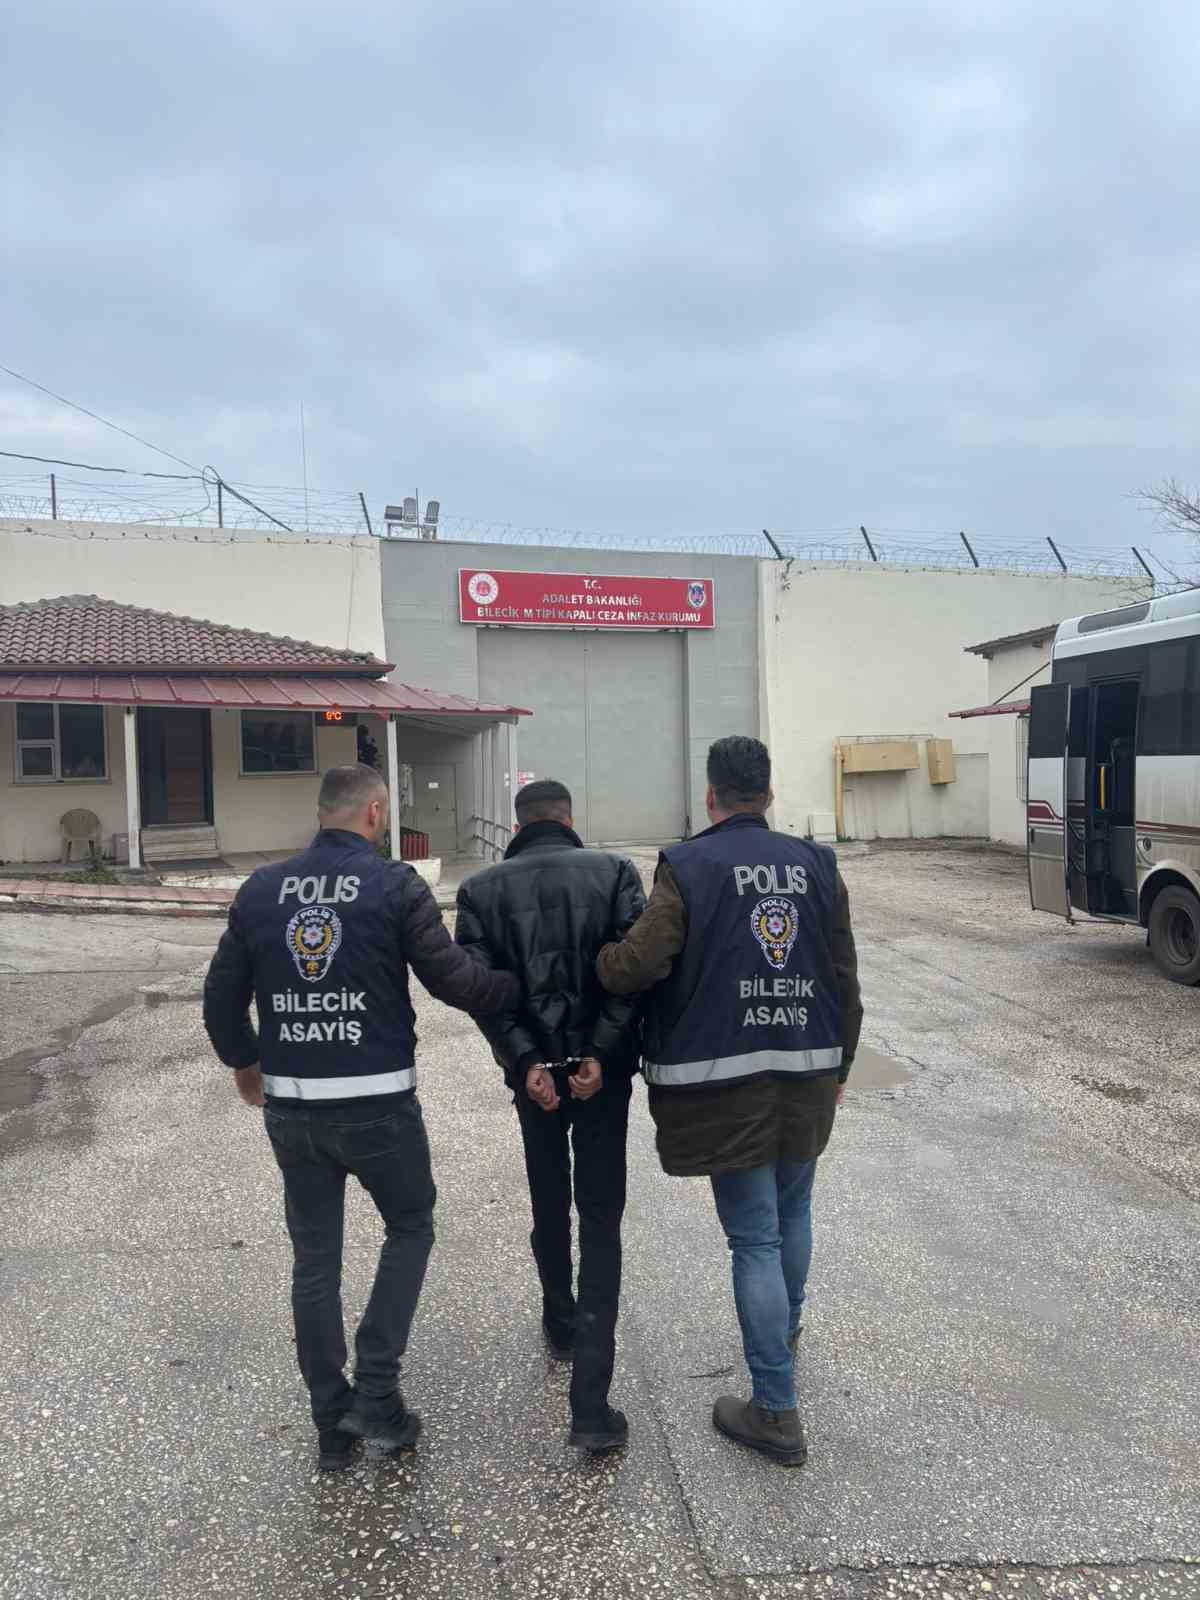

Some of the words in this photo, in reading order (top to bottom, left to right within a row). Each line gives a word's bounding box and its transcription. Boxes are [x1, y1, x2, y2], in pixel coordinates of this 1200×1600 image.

[583, 580, 602, 590] T.C.
[542, 593, 585, 604] ADALET
[586, 594, 642, 606] BAKANLIĞI
[477, 605, 520, 618] BİLECİK
[523, 608, 533, 618] M
[558, 608, 596, 620] KAPALI
[597, 610, 625, 621] CEZA
[626, 609, 657, 621] İNFAZ
[657, 611, 701, 623] KURUMU
[739, 973, 815, 999] BİLECİK
[271, 986, 368, 1013] BİLECİK
[743, 1001, 809, 1031] ASAYİŞ
[279, 1016, 363, 1046] ASAYİŞ
